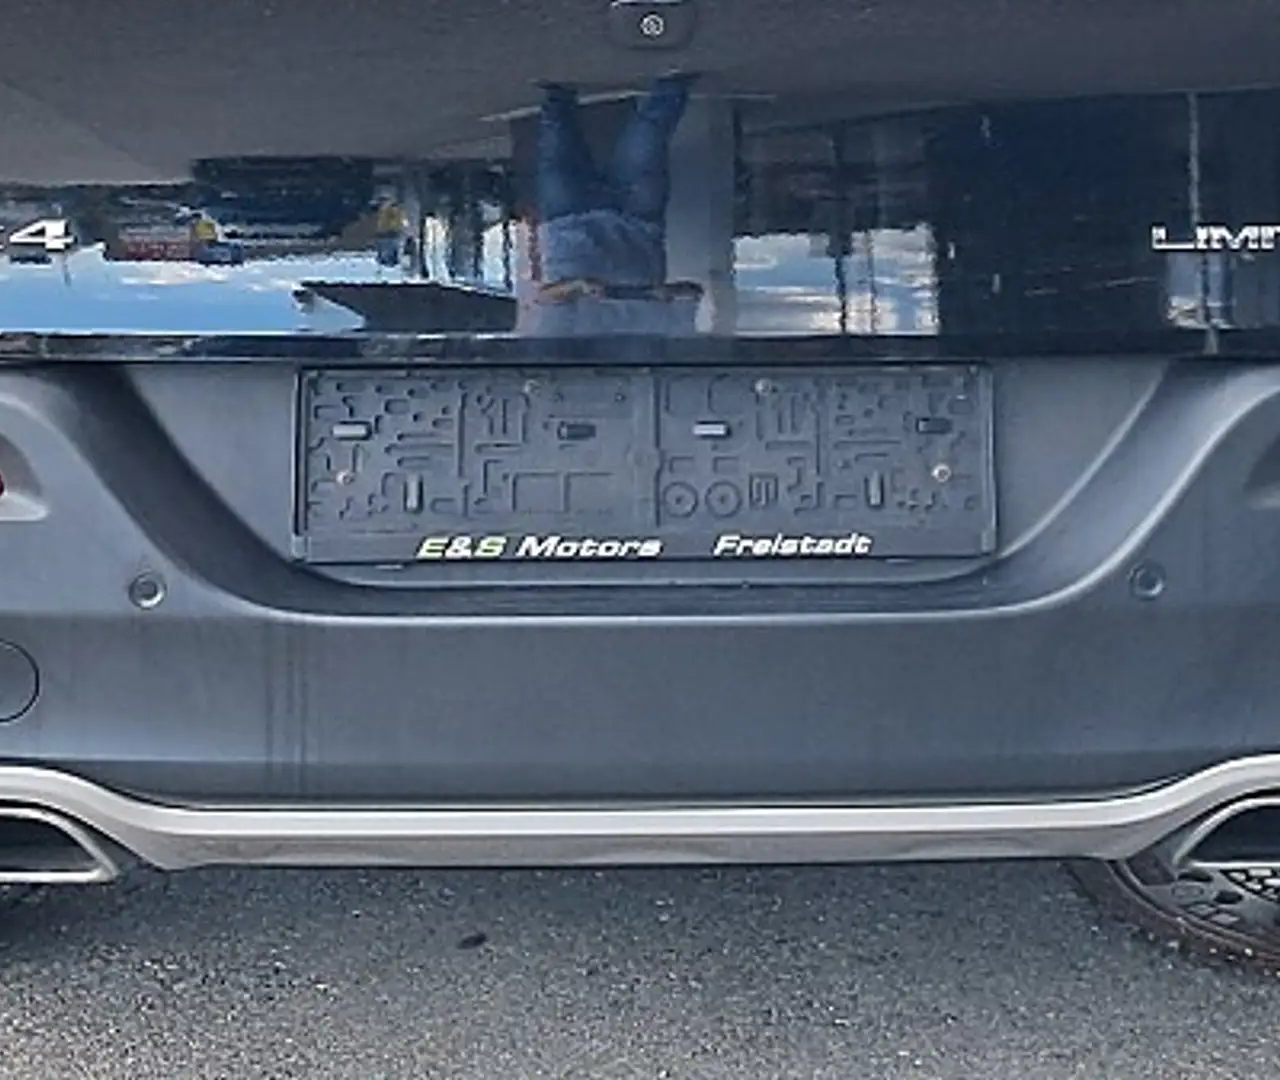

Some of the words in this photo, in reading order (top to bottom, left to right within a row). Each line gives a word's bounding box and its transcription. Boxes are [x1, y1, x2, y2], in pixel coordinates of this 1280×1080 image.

[418, 536, 507, 559] E&S
[516, 535, 662, 558] Motors
[714, 534, 872, 556] Freistadt
